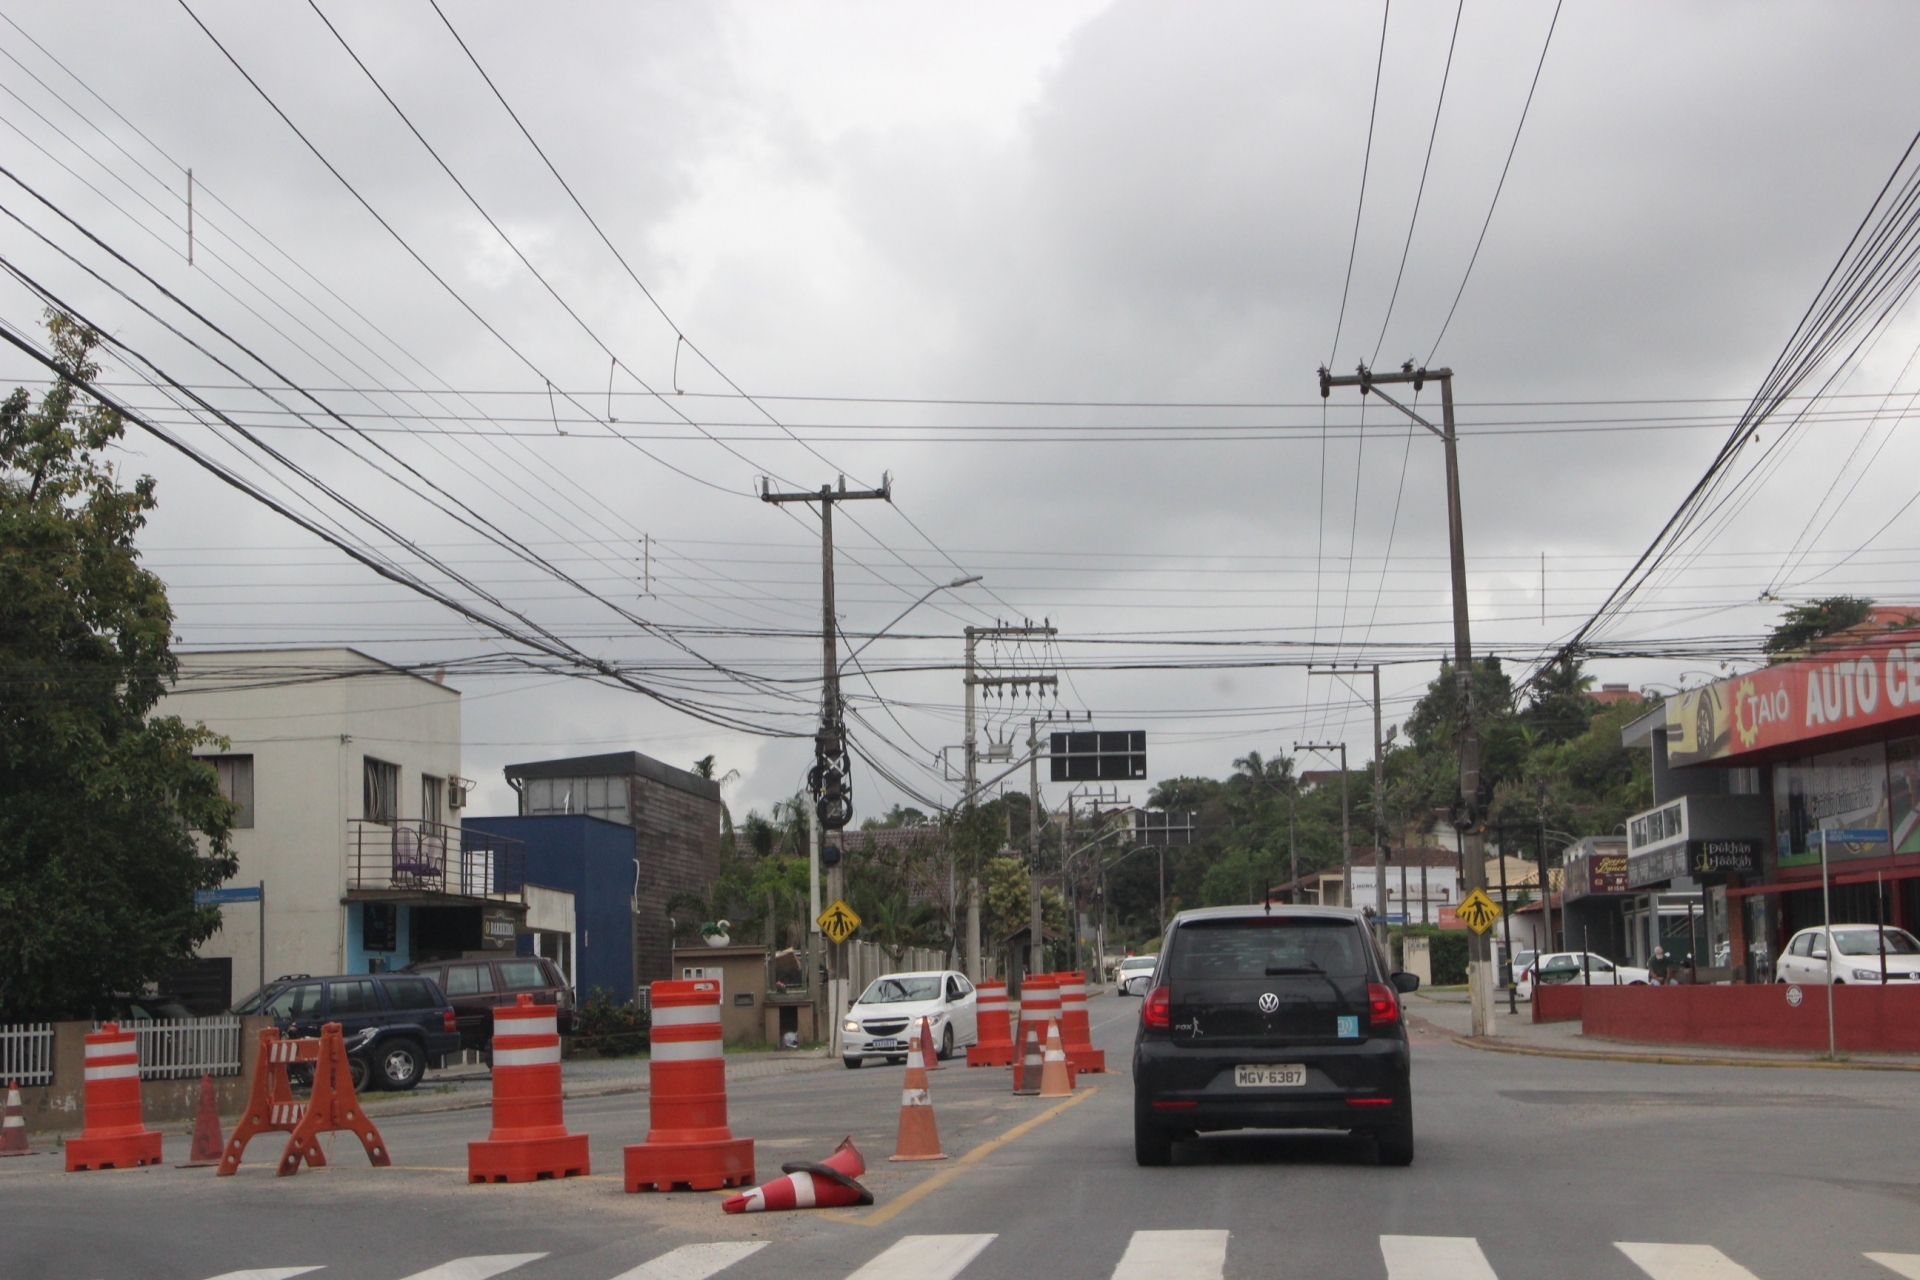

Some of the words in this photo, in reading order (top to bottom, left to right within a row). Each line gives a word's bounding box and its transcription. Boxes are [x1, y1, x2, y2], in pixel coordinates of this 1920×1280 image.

[1748, 681, 1790, 726] TAIÓ
[1805, 654, 1878, 727] AUTO
[1175, 1023, 1192, 1031] FOX
